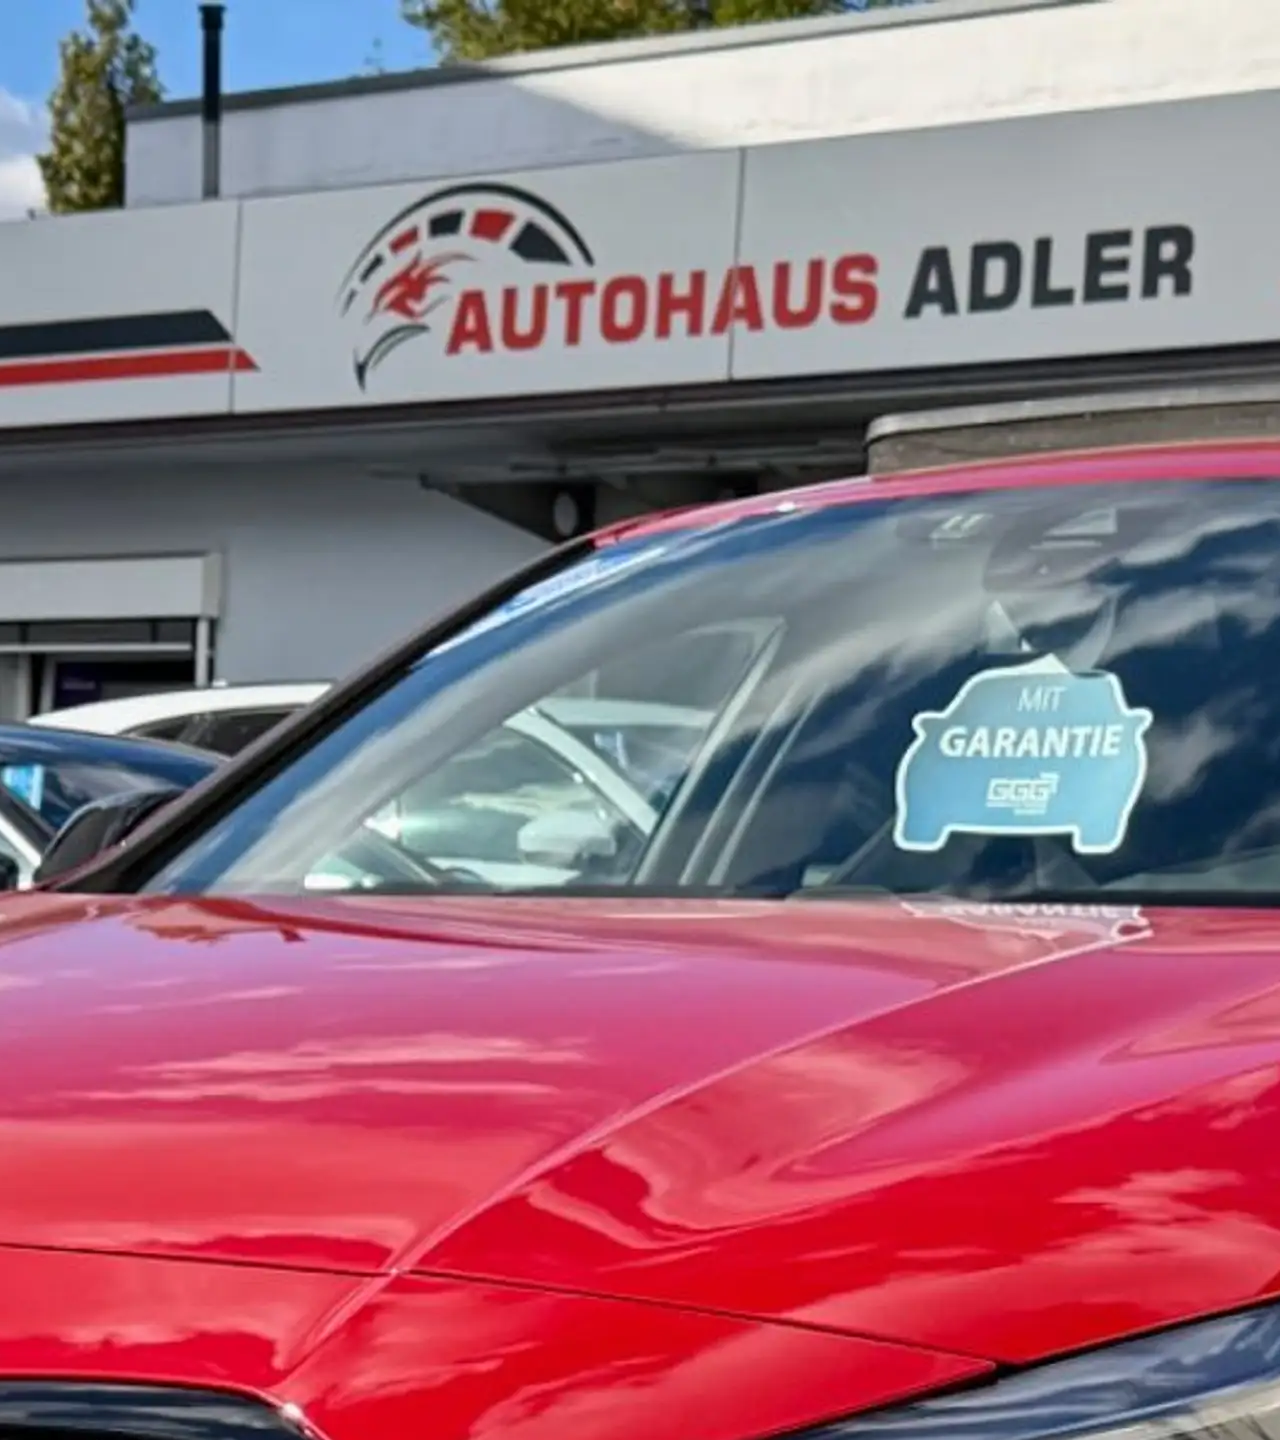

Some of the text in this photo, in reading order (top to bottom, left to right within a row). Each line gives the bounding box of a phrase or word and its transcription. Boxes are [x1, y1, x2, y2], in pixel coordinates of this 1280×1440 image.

[445, 223, 1196, 357] AUTOHAUS ADLER
[1016, 685, 1068, 712] MIT
[939, 724, 1125, 759] GARANTIE
